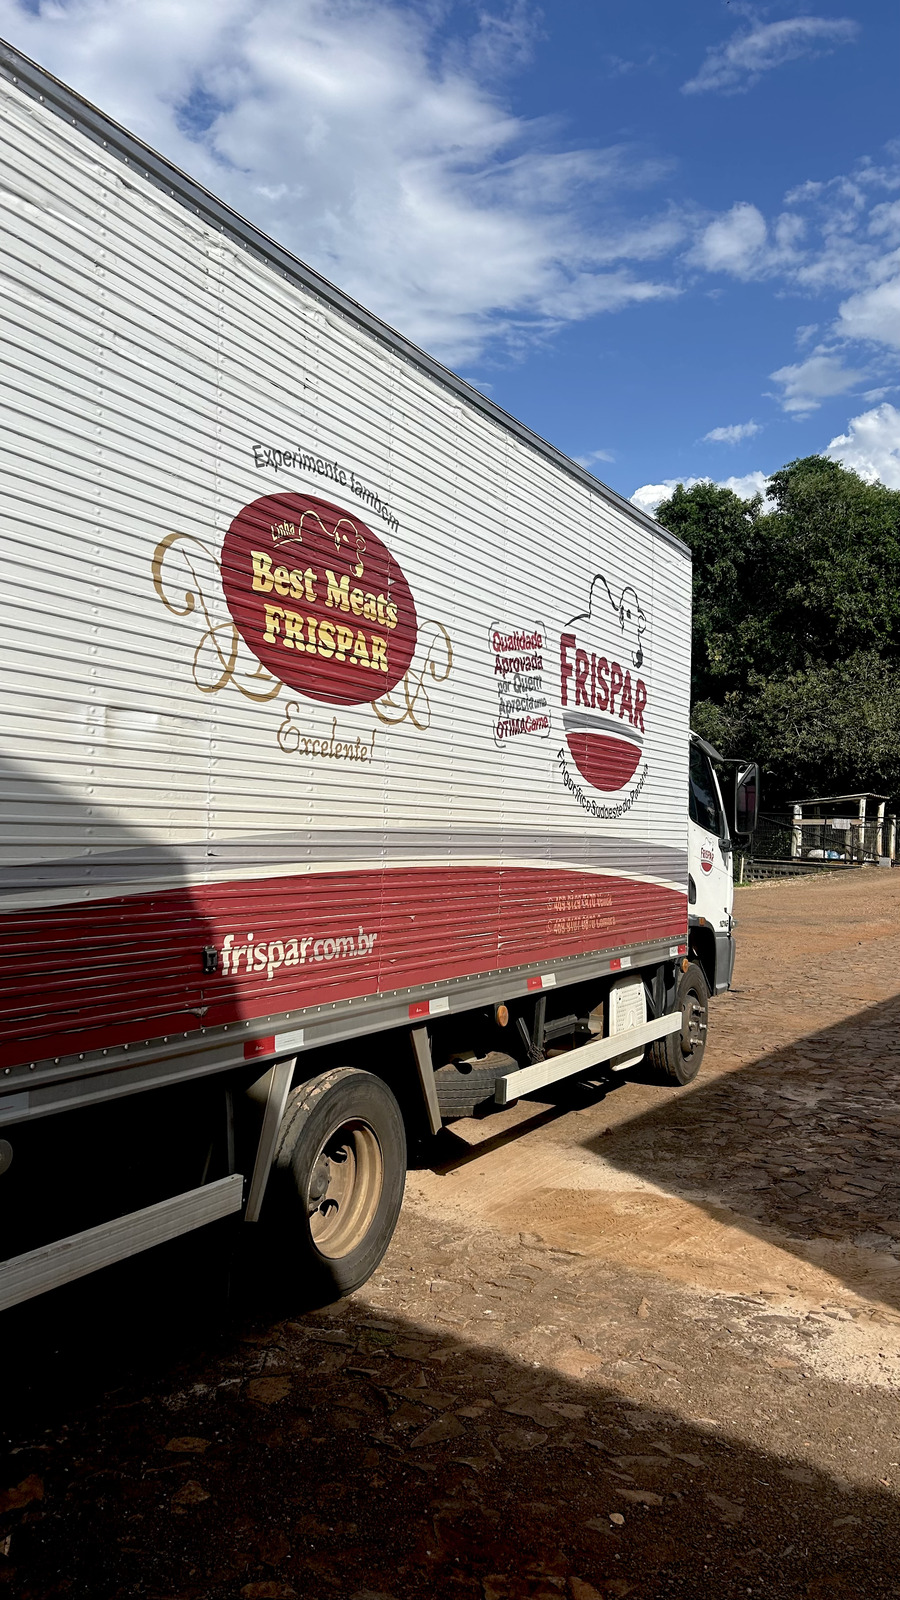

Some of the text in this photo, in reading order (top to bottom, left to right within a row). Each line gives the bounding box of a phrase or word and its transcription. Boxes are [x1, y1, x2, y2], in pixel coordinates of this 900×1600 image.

[252, 445, 399, 533] Experimente também
[271, 520, 295, 541] Linha
[251, 550, 398, 628] Best Meats
[262, 603, 389, 672] FRISPAR
[493, 631, 542, 652] Qualidade
[495, 651, 543, 679] Aprovada
[498, 674, 542, 697] por Quem
[560, 633, 647, 734] FRISPAR
[499, 694, 533, 718] Aprecia
[277, 701, 377, 764] Excelente!
[525, 715, 548, 732] Carne
[591, 800, 622, 819] Sudoeste
[622, 798, 630, 813] do
[220, 926, 377, 981] frispar.com.br
